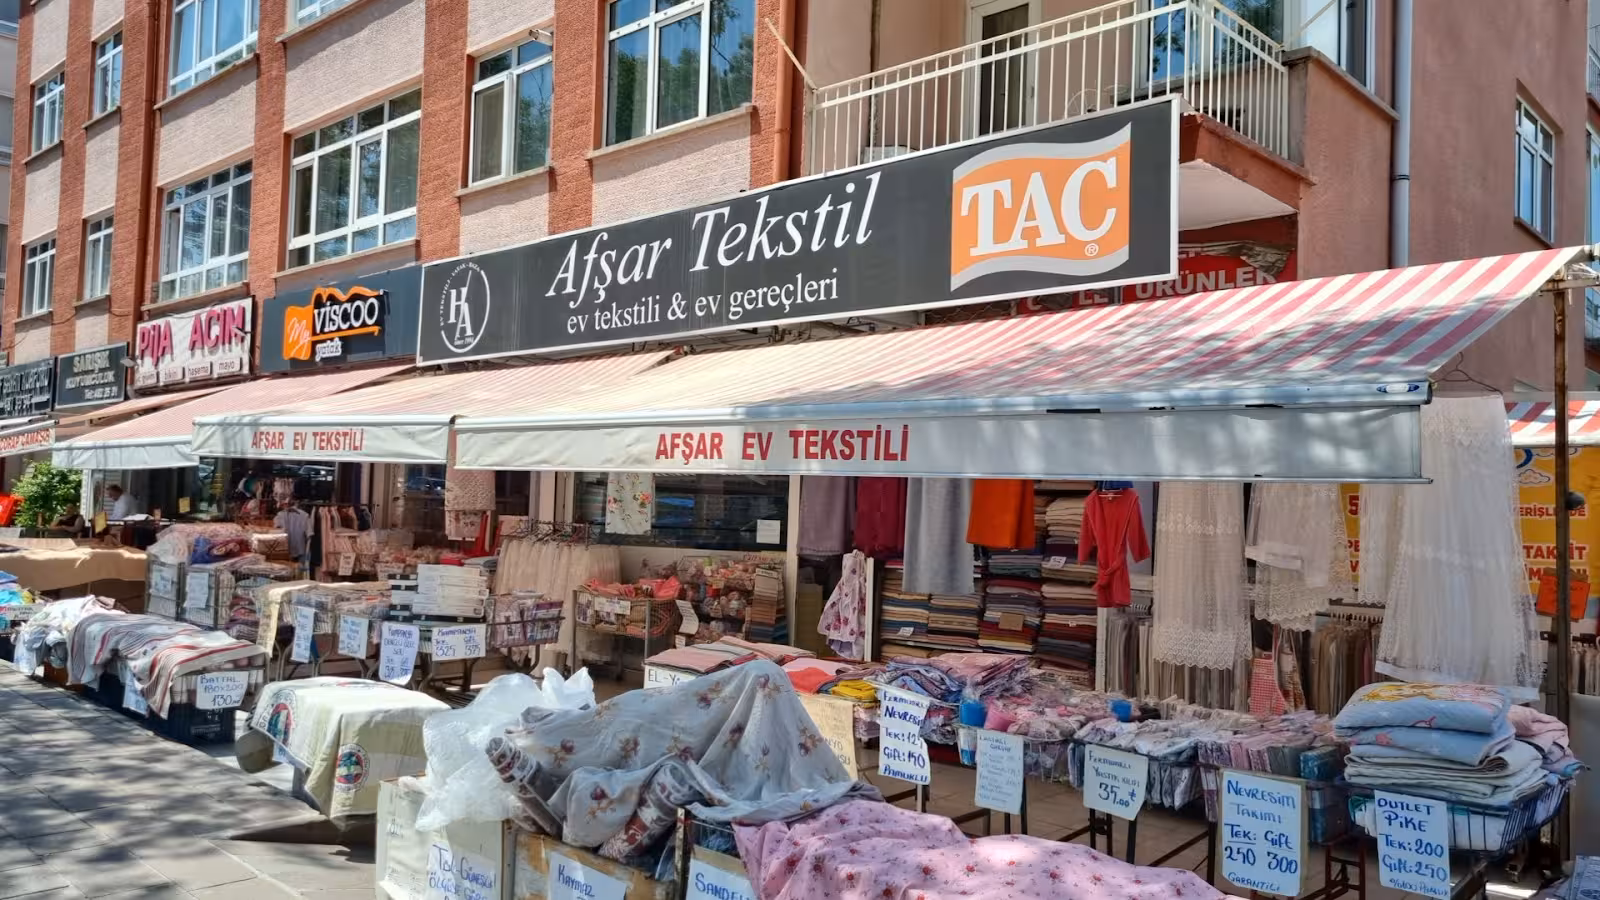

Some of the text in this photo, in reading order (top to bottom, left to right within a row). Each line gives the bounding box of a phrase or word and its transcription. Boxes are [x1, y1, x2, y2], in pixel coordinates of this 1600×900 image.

[960, 156, 1117, 256] TAC
[545, 171, 882, 308] Afşar Tekstil
[567, 268, 839, 334] ev tekstili & ev gereçleri
[251, 428, 364, 454] AFŞAR EV TEKSTİLİ
[655, 424, 909, 465] AFŞAR EV TEKSTİLİ
[1377, 798, 1435, 815] OUTLET
[1225, 846, 1298, 874] 250 300
[1415, 838, 1444, 858] 200
[1414, 861, 1447, 882] 250
